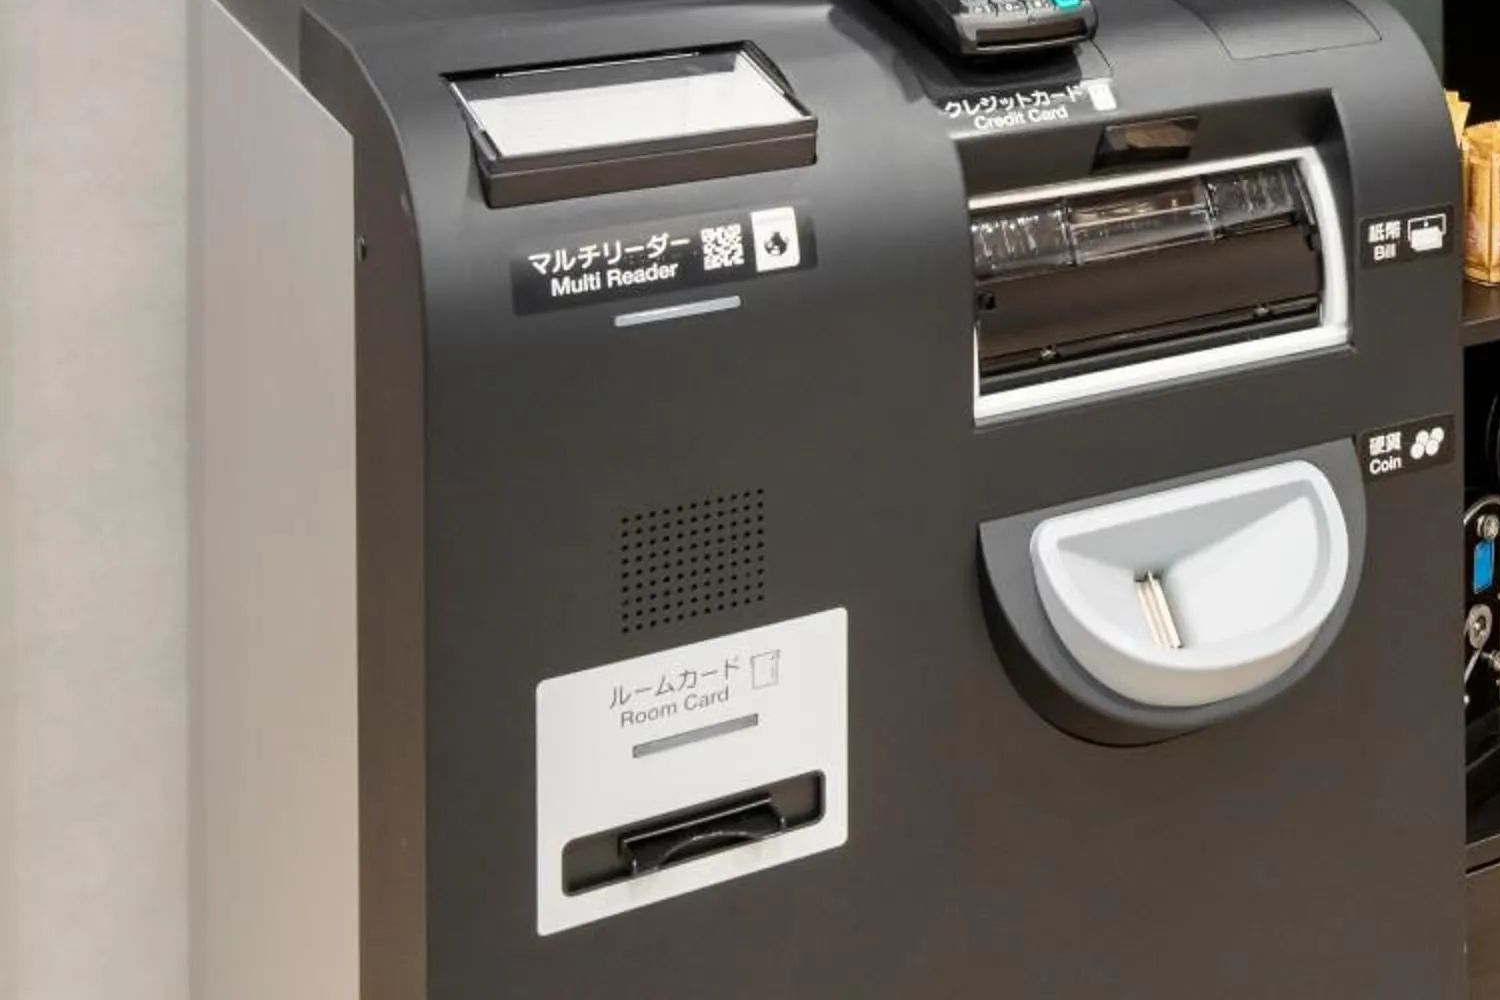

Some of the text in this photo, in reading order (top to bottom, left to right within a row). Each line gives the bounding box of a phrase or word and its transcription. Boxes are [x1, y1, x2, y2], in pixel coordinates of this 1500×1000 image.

[944, 84, 1084, 119] クレジットカード
[973, 104, 1069, 131] Credit Card
[528, 232, 691, 275] マルチリーダー
[1373, 242, 1397, 262] Bill
[551, 261, 680, 297] Multi Reader
[1369, 455, 1402, 475] Coin
[609, 655, 741, 710] ルームカード
[620, 686, 730, 729] Room Card
